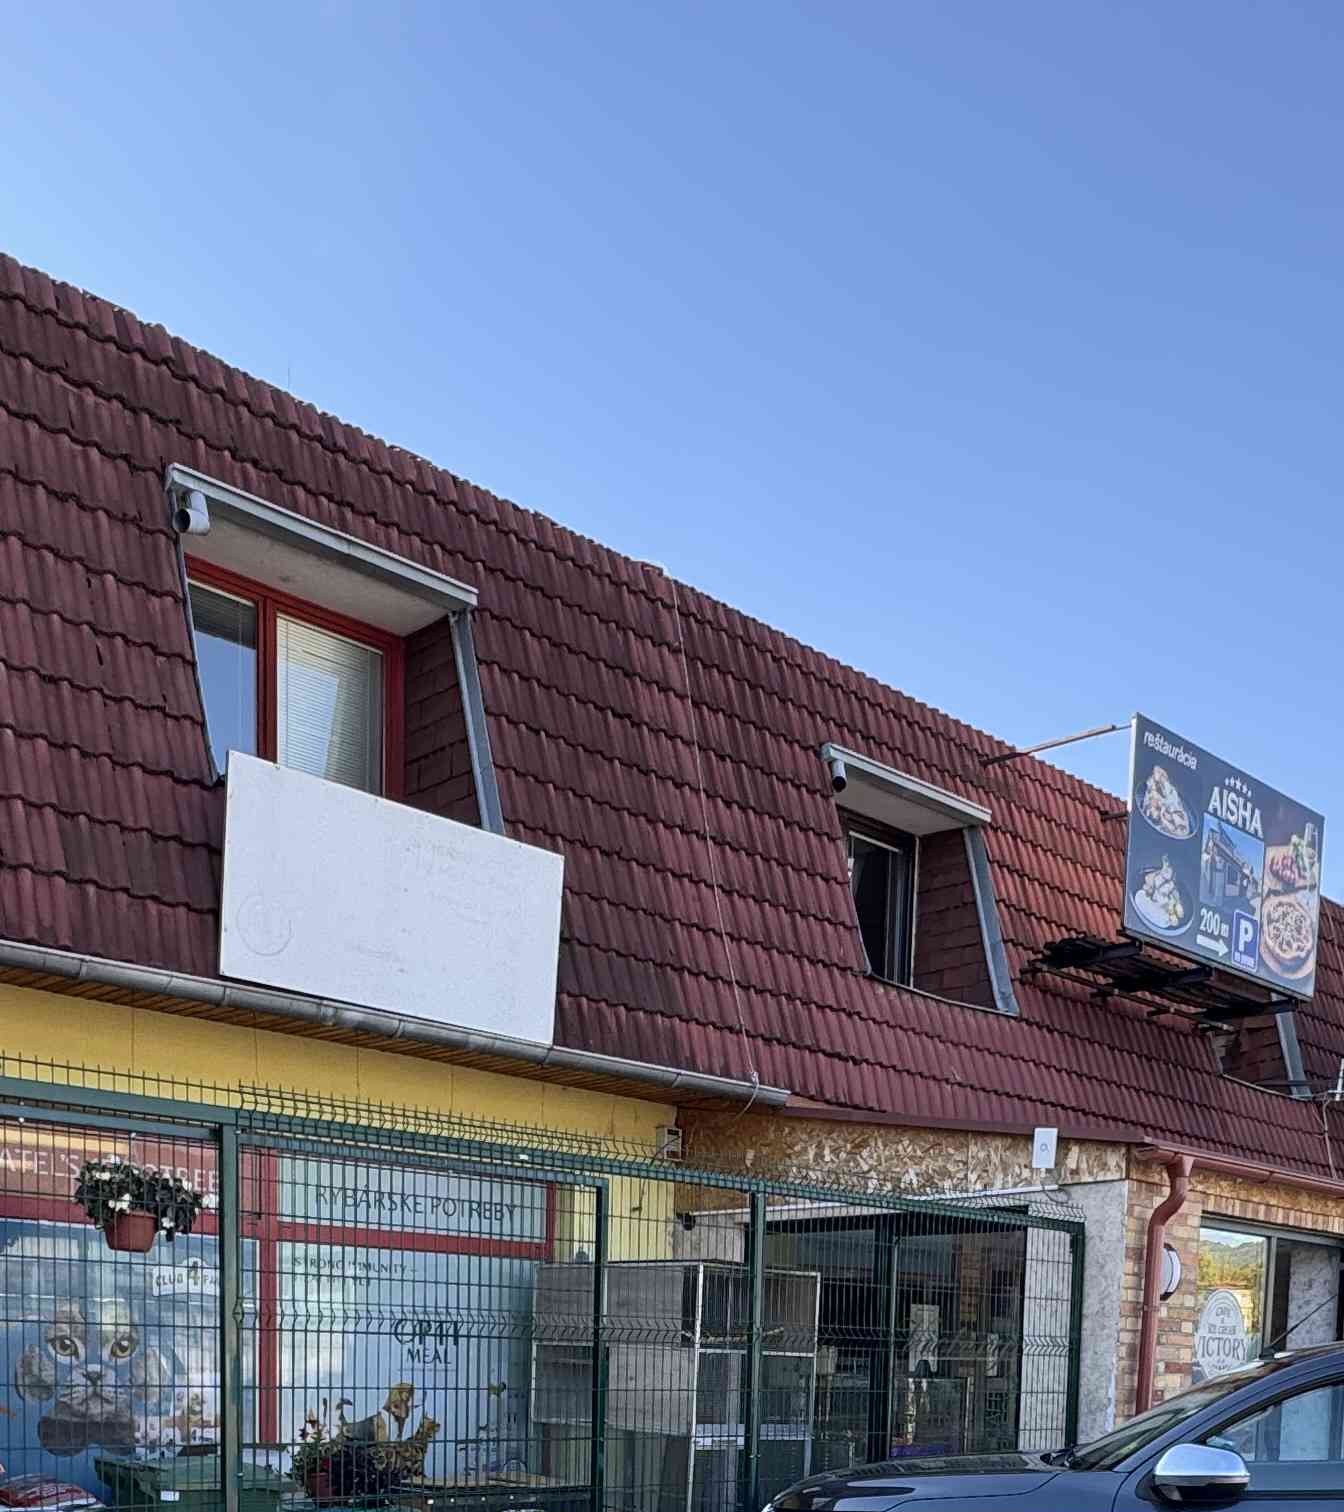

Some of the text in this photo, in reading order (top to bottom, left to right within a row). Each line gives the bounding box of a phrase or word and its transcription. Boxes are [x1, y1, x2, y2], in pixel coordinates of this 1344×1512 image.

[1207, 786, 1264, 840] AISHA
[1199, 907, 1230, 938] 200 m
[1238, 918, 1254, 952] P
[315, 1184, 517, 1222] RYBÁRSKE POTREBY
[407, 1348, 452, 1366] MEAL
